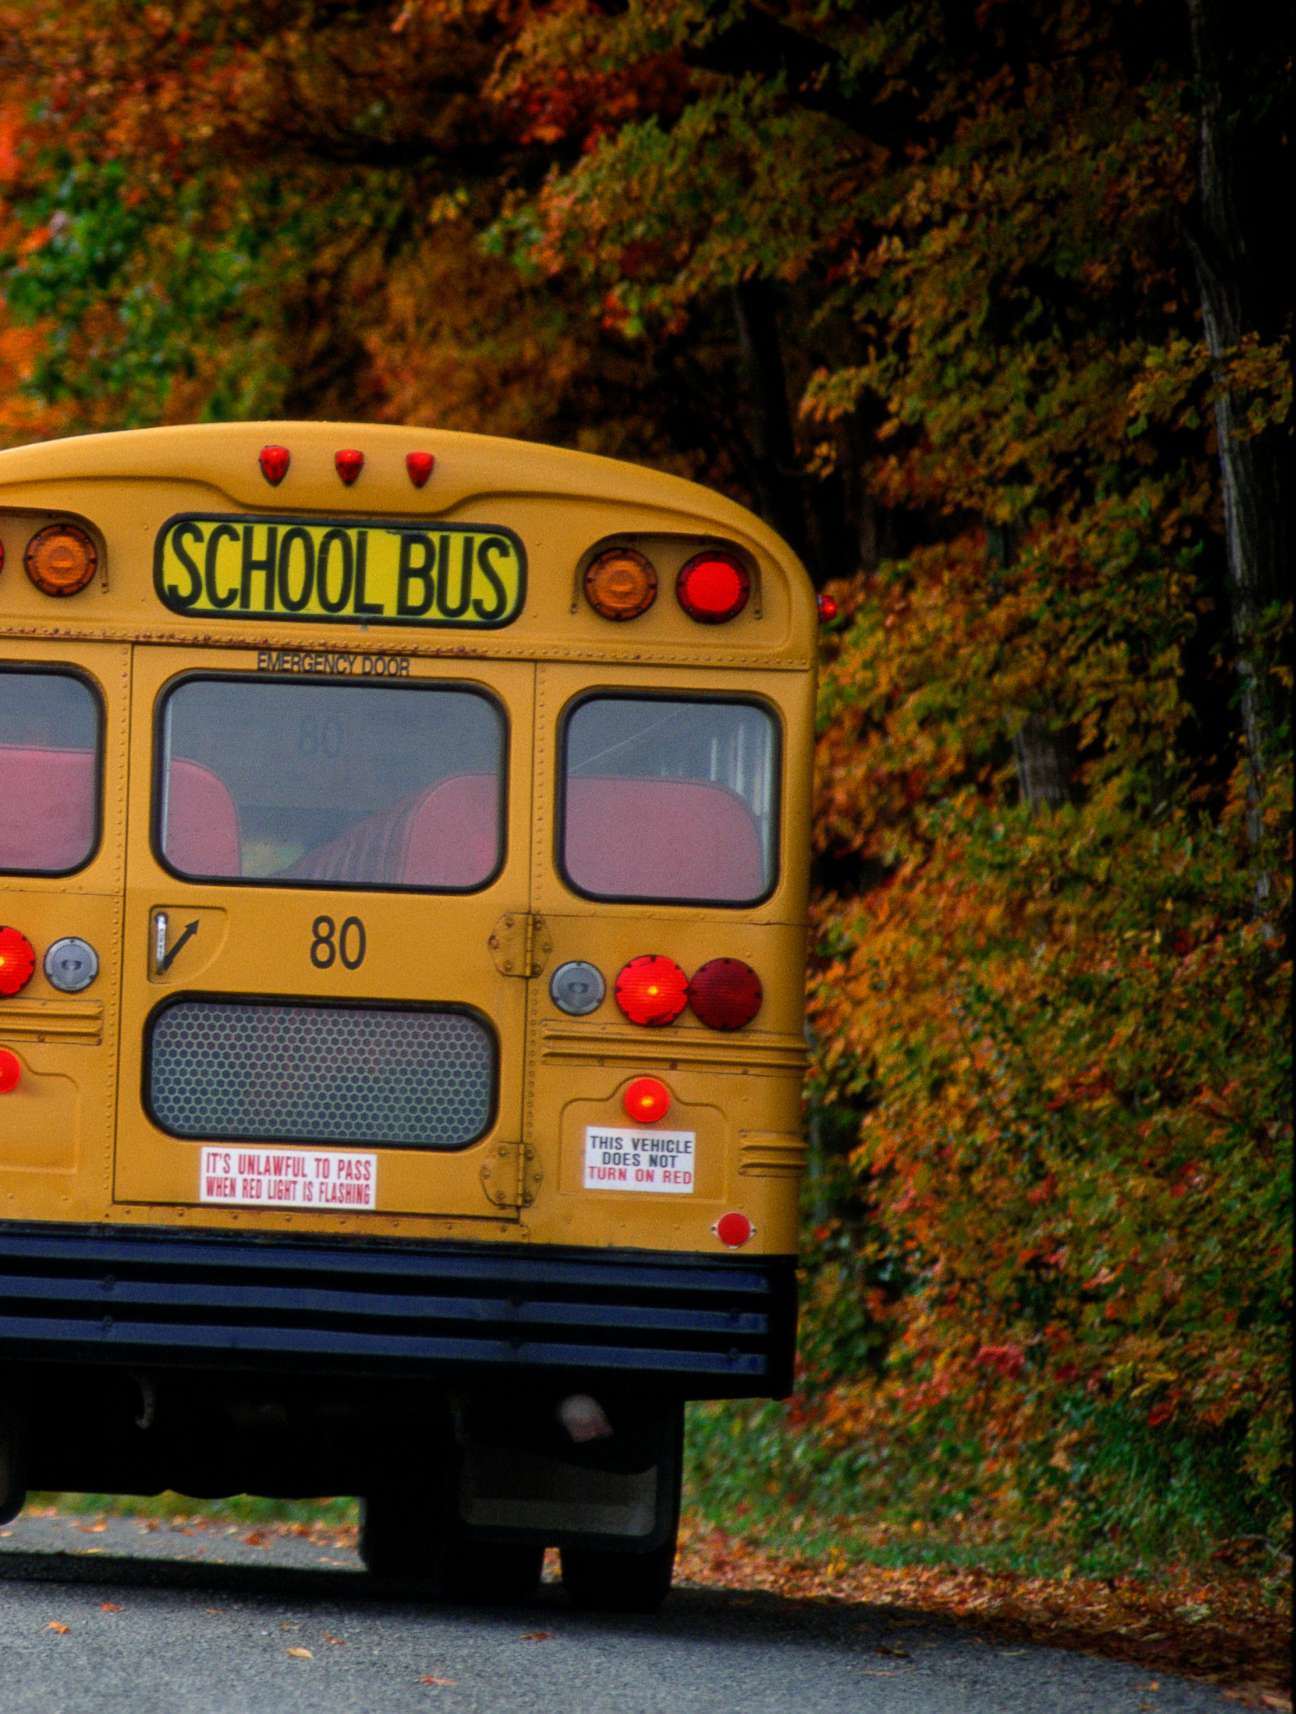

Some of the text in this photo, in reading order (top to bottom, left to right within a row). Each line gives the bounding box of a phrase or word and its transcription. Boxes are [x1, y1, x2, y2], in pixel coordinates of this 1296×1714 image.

[167, 522, 510, 620] SCHOOL BUS
[257, 651, 410, 676] EMERGENCY DOOR
[310, 915, 366, 970] 80
[590, 1136, 692, 1153] THIS VEHICLE
[206, 1153, 371, 1181] IT'S UNLAWFUL TO PASS
[602, 1152, 678, 1168] DOES NOT
[589, 1167, 692, 1184] TURN ON RED
[206, 1177, 370, 1204] WHEN RED LIGHT IS FLASHING
